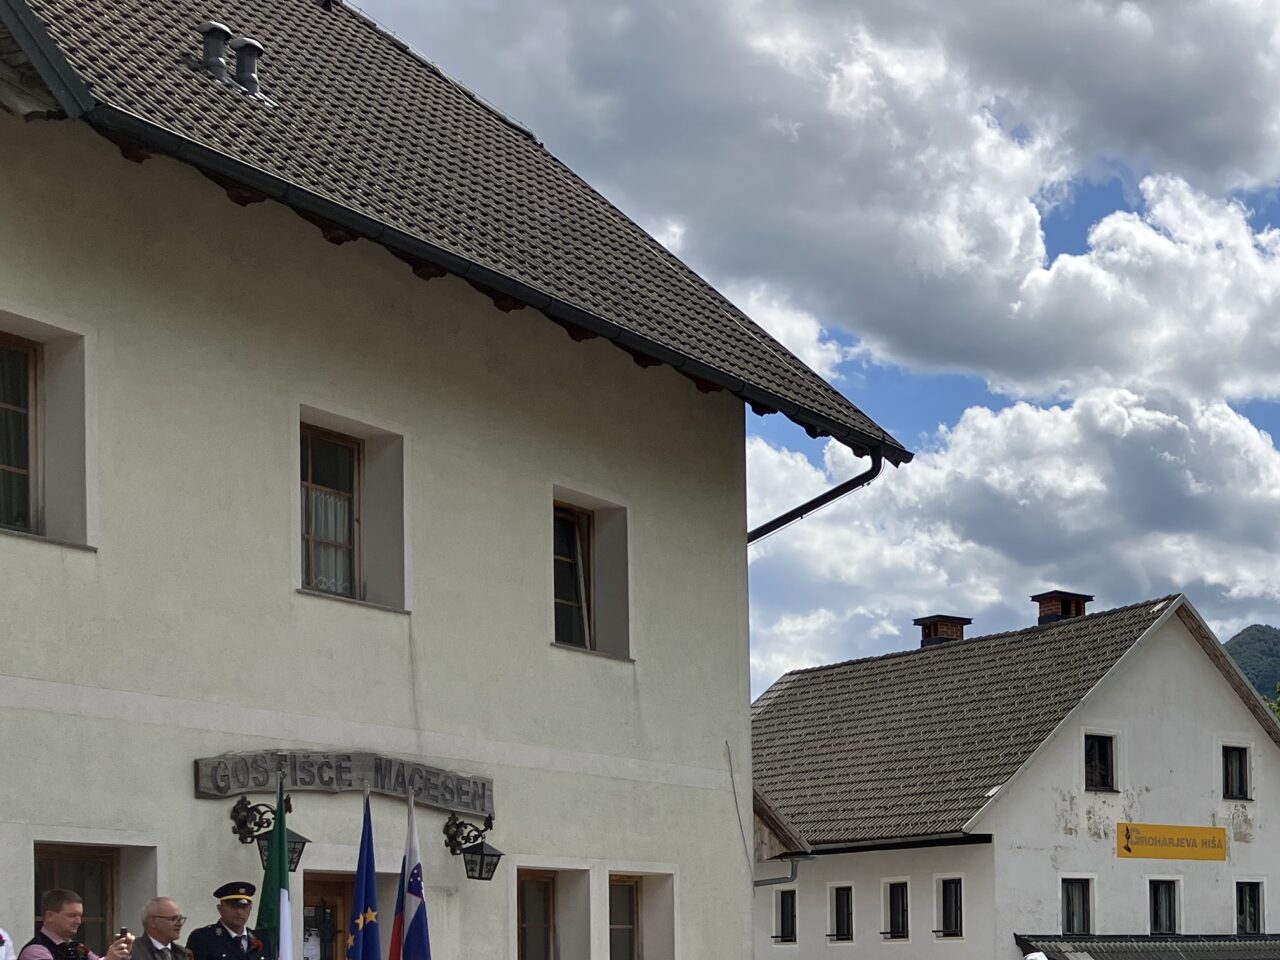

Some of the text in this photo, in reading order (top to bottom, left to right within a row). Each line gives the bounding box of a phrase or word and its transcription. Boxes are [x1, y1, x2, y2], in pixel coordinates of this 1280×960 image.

[211, 752, 486, 811] GOSTIŠČE MACESEN
[1201, 836, 1223, 849] HIŠA
